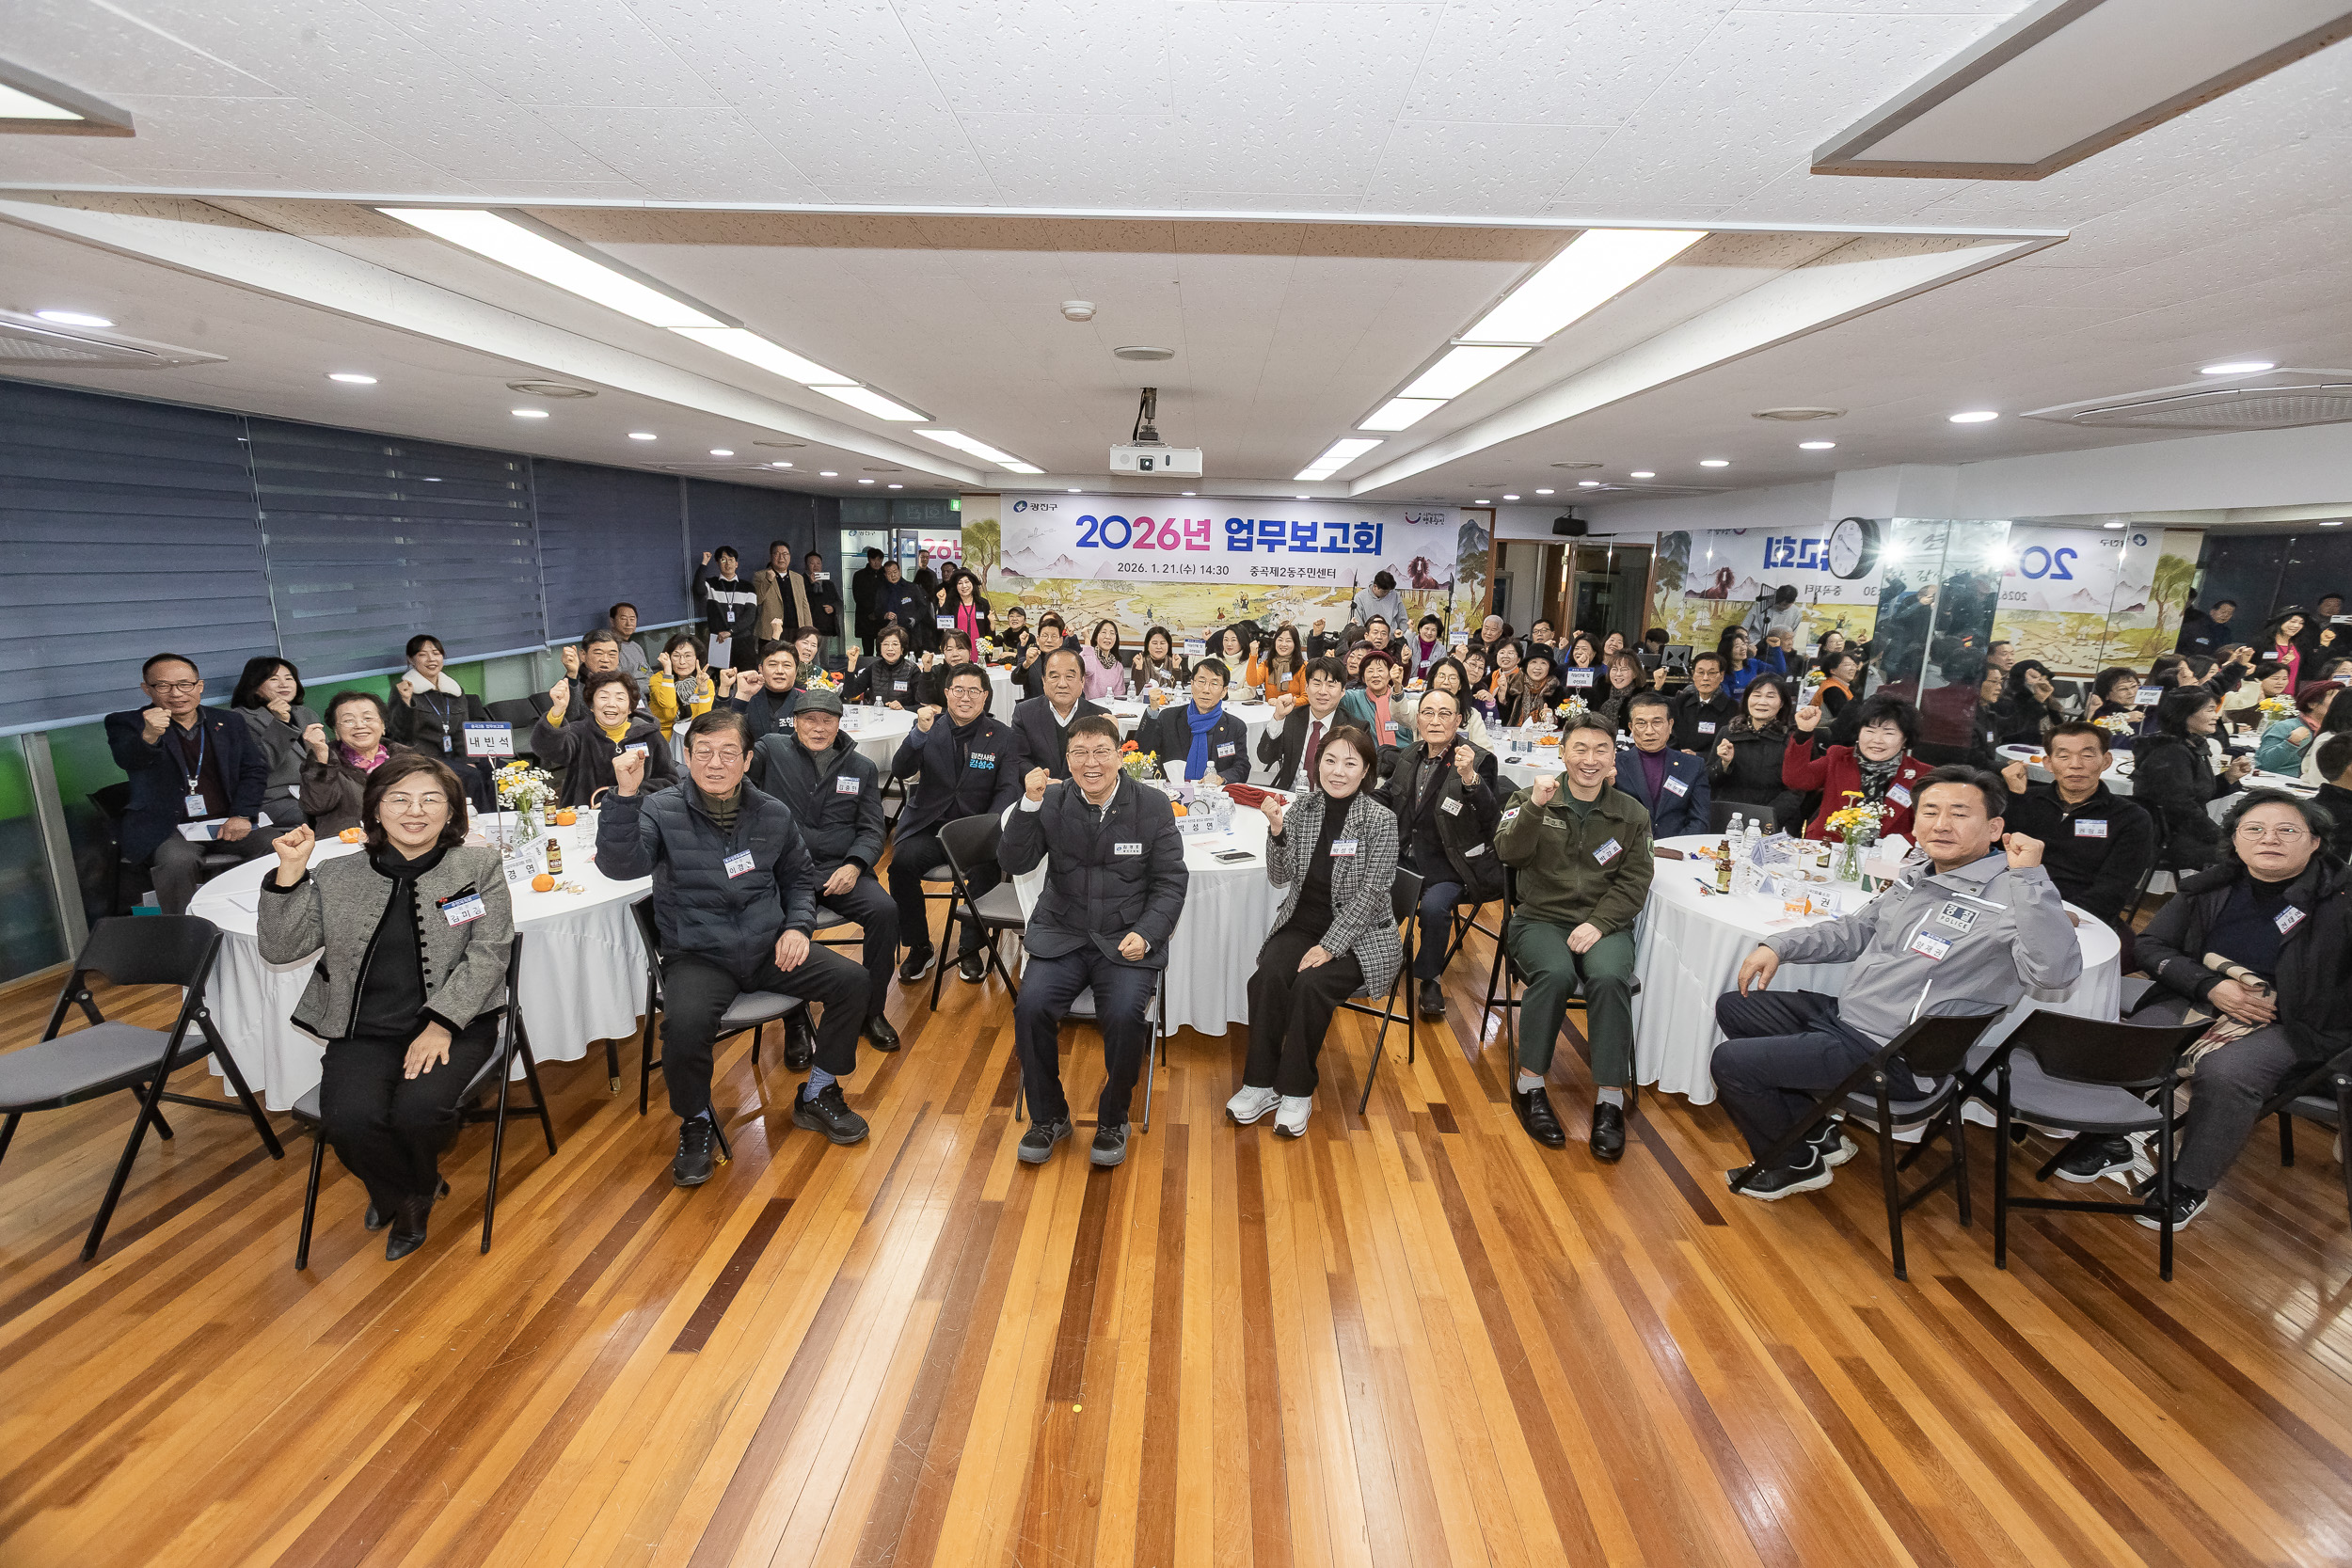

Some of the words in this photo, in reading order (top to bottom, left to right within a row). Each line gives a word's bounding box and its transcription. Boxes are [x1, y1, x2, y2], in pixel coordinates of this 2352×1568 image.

[1029, 502, 1058, 512] 광진구
[1075, 515, 1212, 551] 2026년
[1224, 517, 1384, 556] 업무보고회
[1117, 562, 1148, 573] 2026.
[1162, 563, 1196, 575] 21.(수)
[1200, 565, 1230, 576] 14:30
[1249, 565, 1337, 579] 중곡제2동주민센터
[469, 736, 510, 749] 내빈석
[1945, 903, 1976, 923] 경찰
[1940, 915, 1968, 929] POLICE
